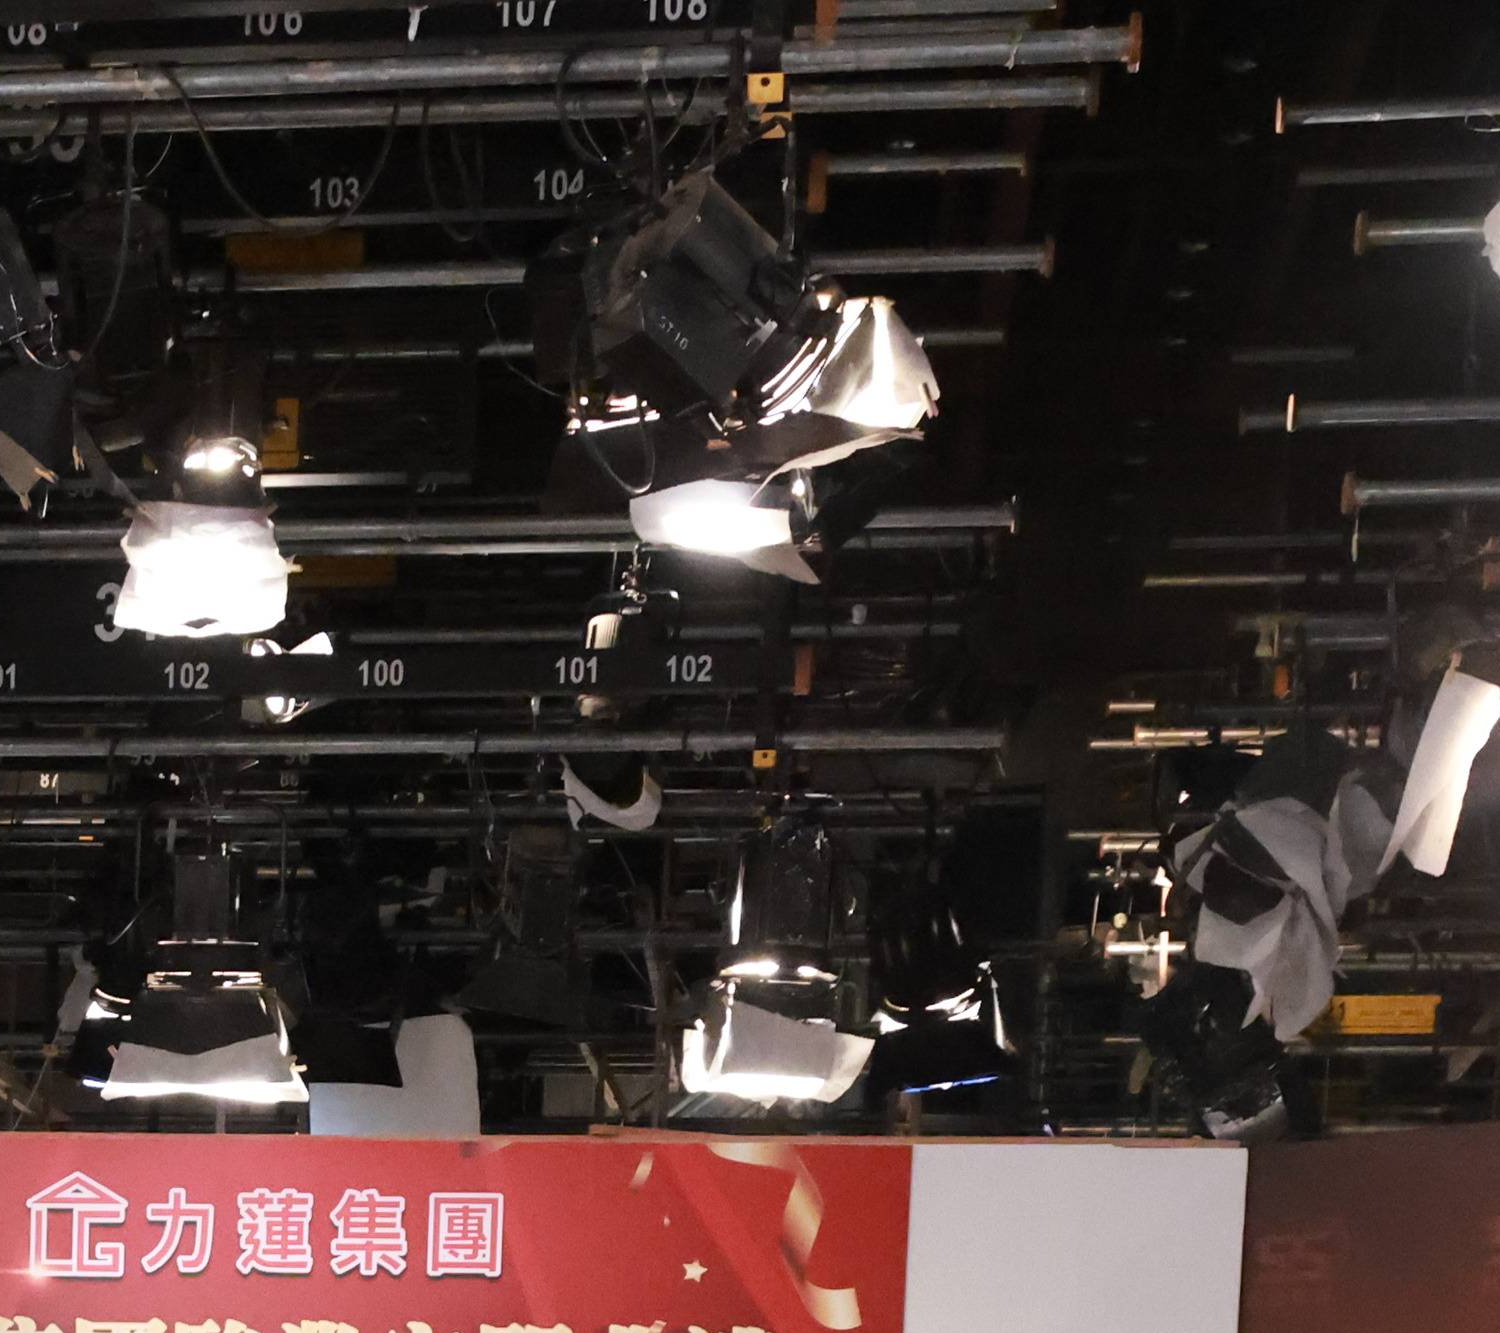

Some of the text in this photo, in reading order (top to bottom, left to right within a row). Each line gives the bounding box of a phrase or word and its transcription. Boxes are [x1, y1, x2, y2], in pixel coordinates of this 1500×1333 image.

[496, 0, 557, 28] 107
[309, 176, 360, 209] 103
[533, 168, 584, 201] 104
[164, 662, 210, 690] 102
[358, 658, 404, 687] 100
[555, 656, 598, 684] 101
[666, 654, 713, 683] 102
[140, 1186, 504, 1277] 力蓮集團
